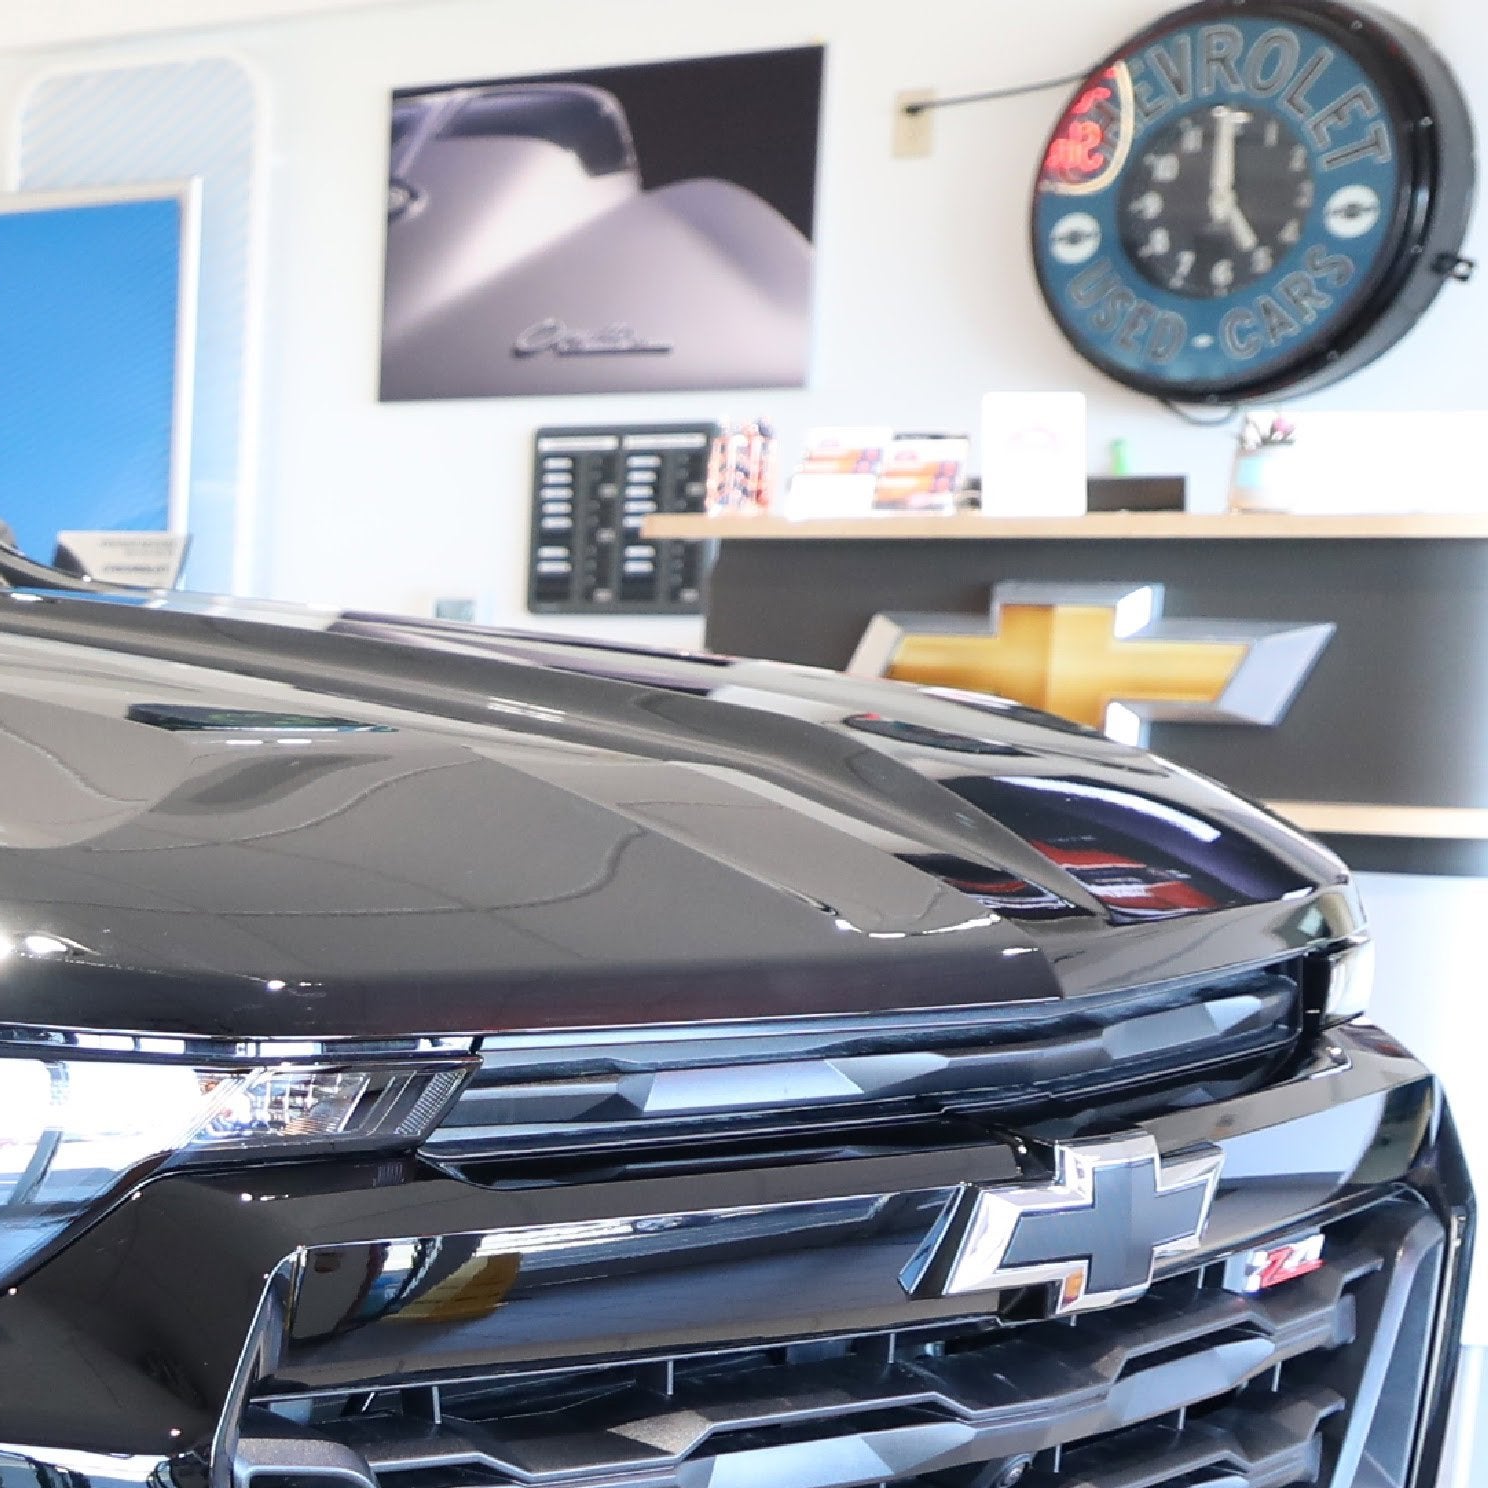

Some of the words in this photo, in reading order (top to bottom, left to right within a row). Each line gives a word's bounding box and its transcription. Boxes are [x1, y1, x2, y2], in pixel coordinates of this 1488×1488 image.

[1058, 22, 1392, 182] EVROLET
[1066, 256, 1188, 366] USED
[1219, 243, 1357, 362] CARS
